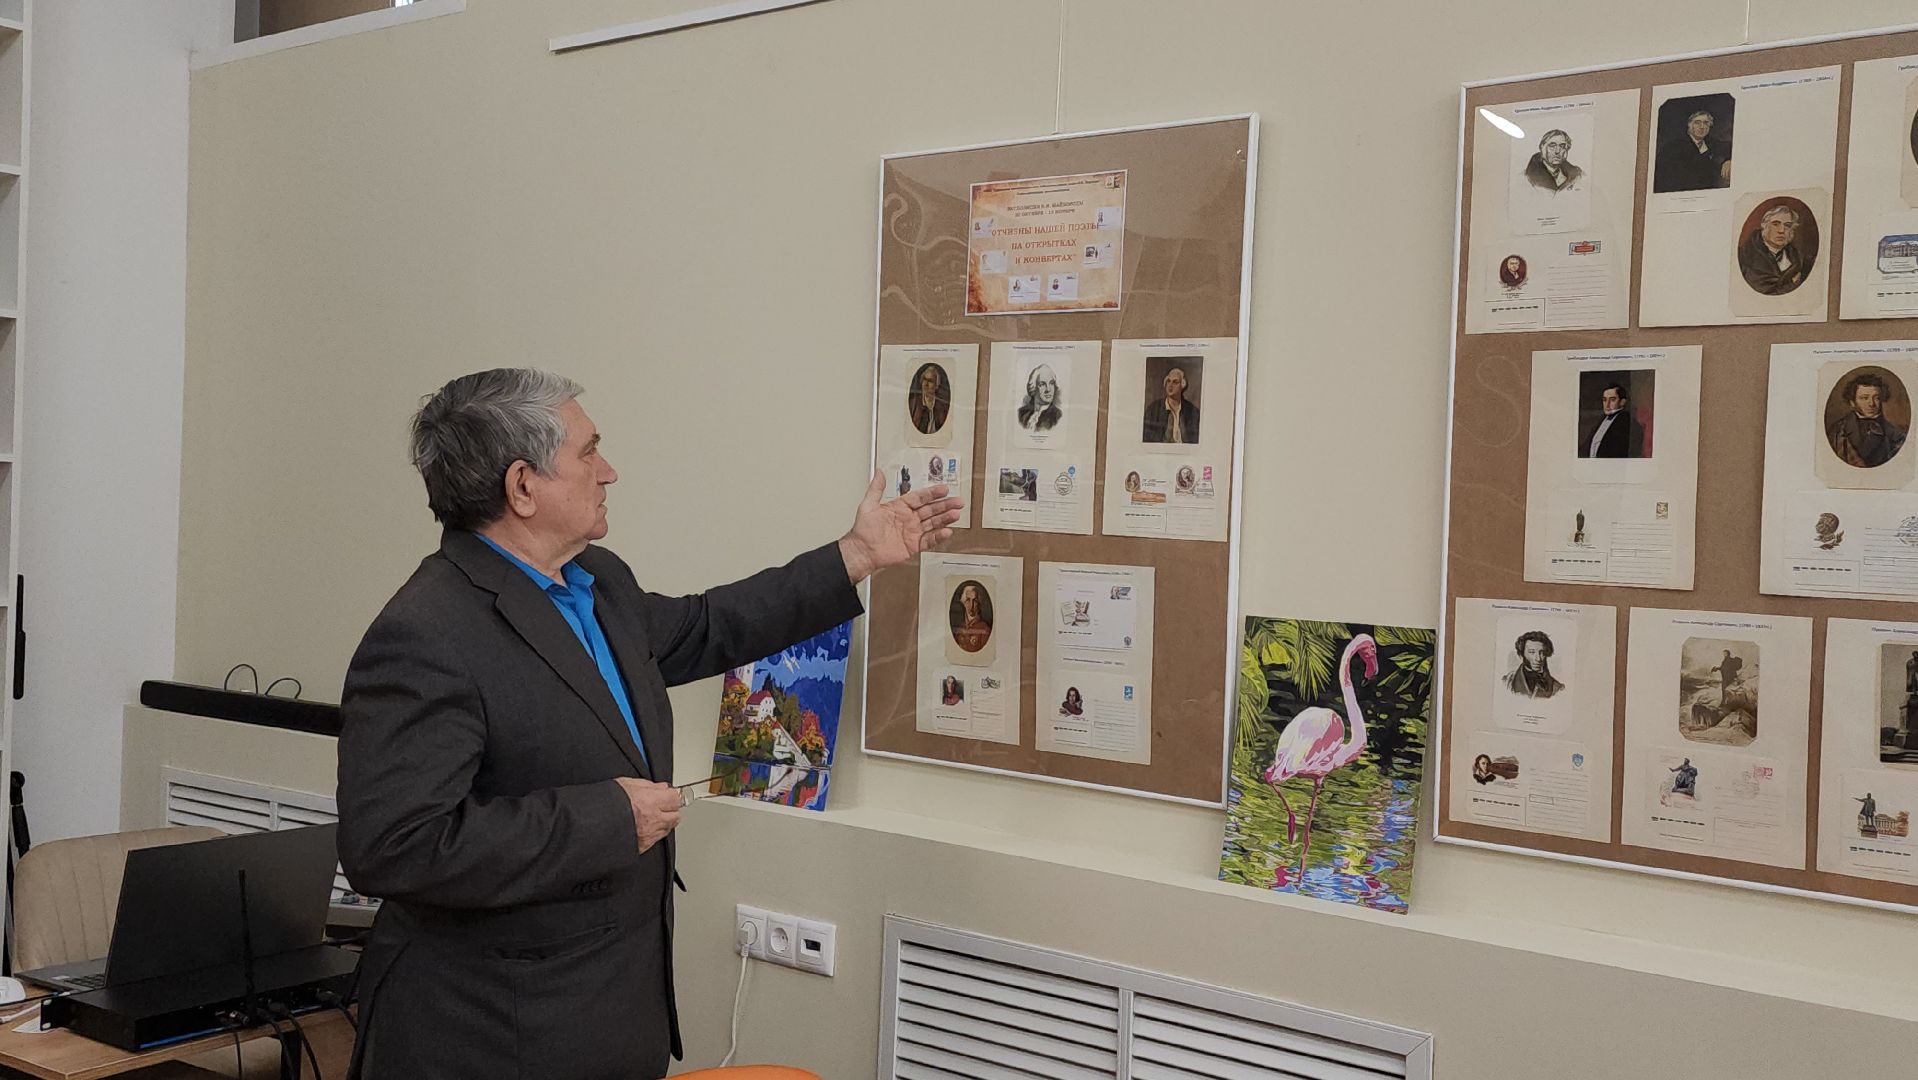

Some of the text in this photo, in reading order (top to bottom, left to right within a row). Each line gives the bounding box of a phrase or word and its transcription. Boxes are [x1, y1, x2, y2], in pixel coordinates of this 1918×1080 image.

[1034, 222, 1066, 234] НАШЕЙ
[1068, 221, 1099, 233] ПОЭТЫ
[1011, 238, 1077, 250] НА ОТКРЫТКАХ
[1015, 256, 1021, 265] И
